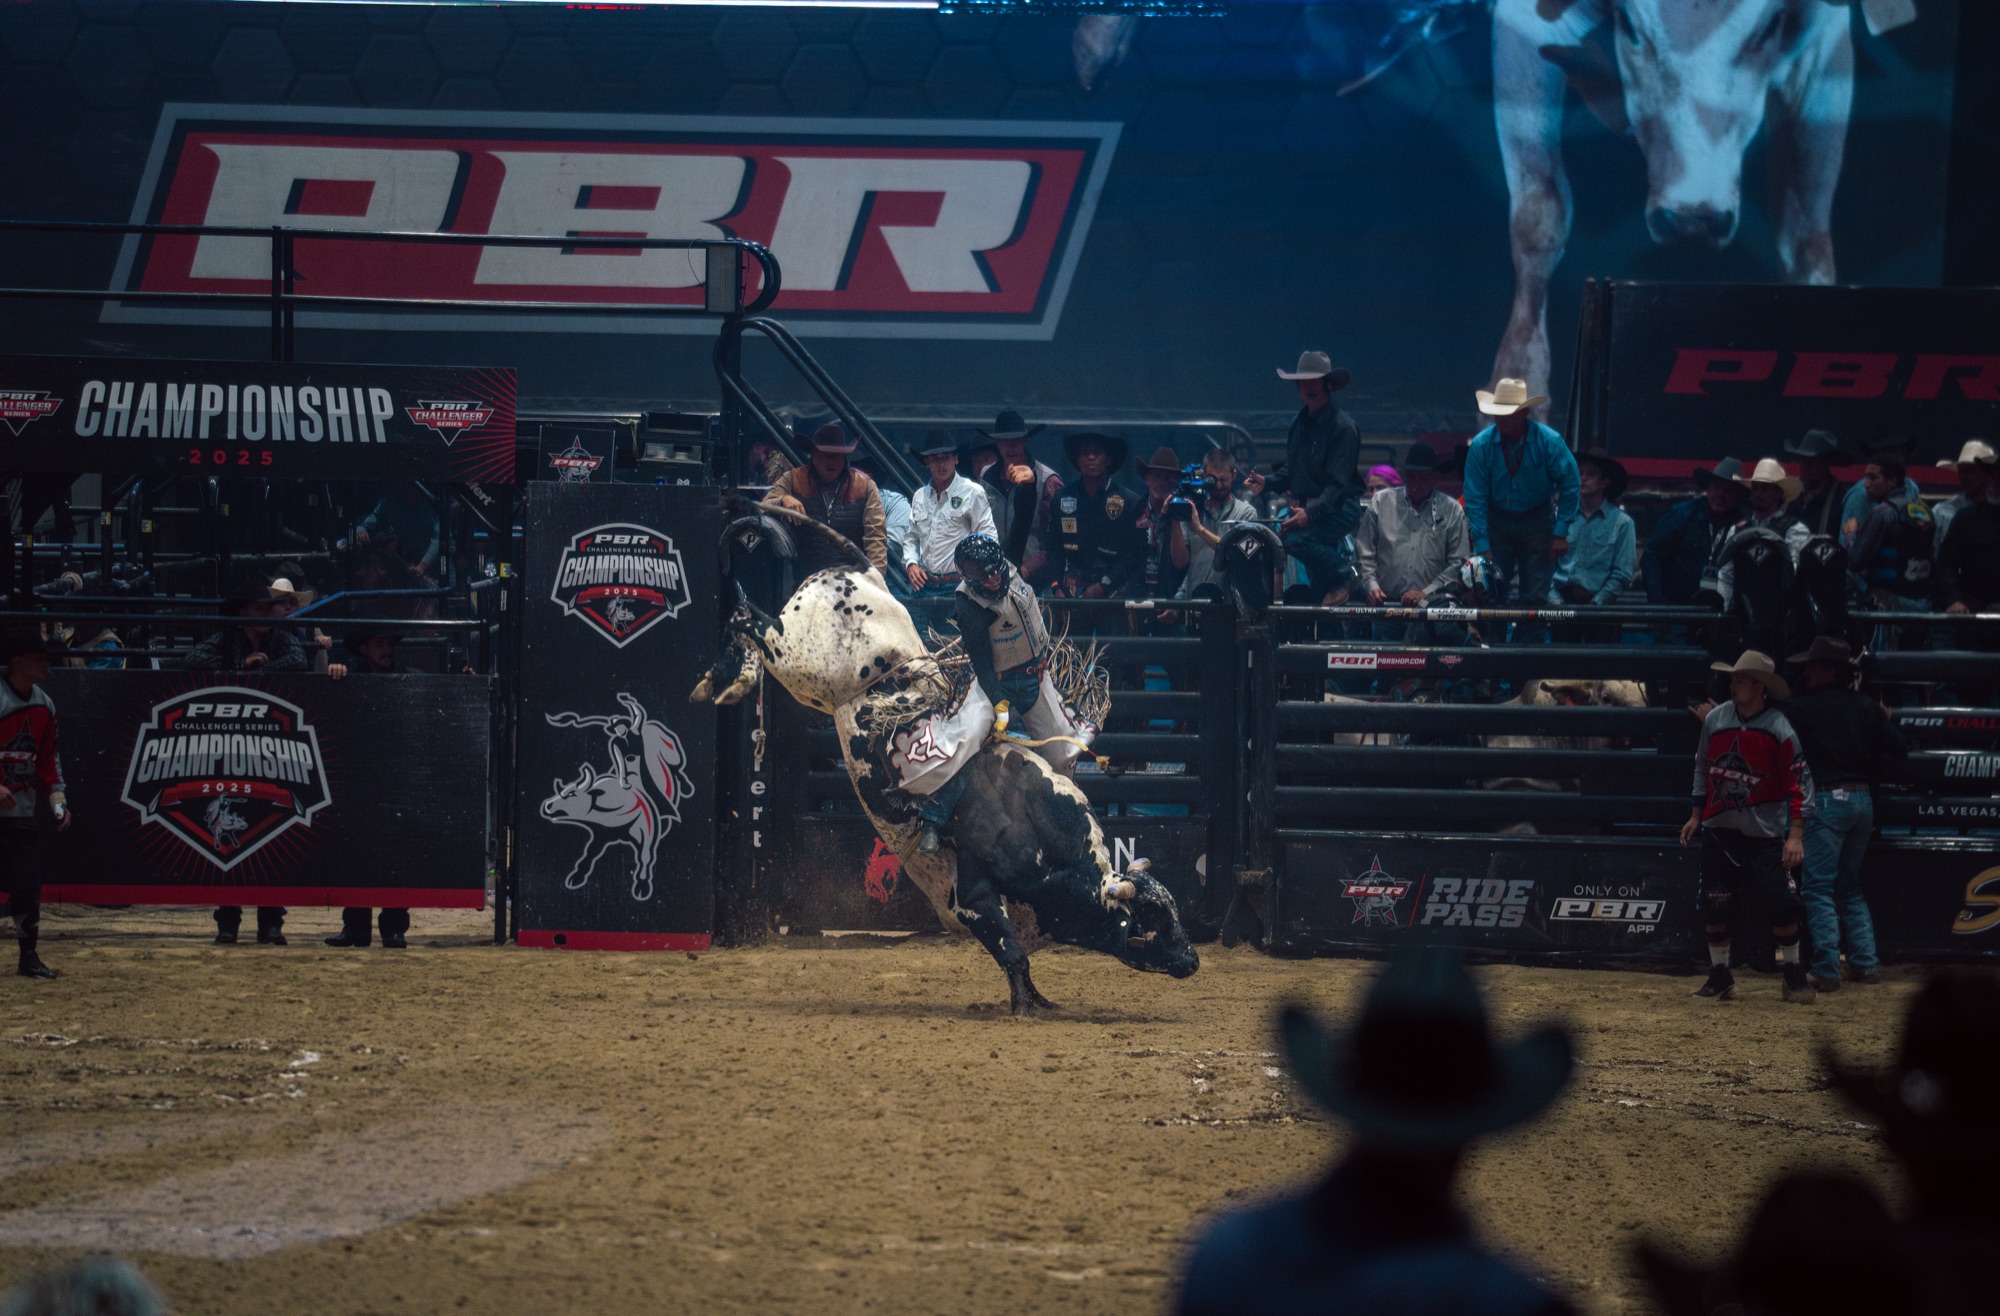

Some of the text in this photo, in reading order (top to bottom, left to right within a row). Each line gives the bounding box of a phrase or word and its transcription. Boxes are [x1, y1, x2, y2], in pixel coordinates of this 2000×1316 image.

[188, 143, 1032, 294] PBR
[1664, 347, 2000, 400] PBR
[0, 401, 52, 411] LLENGER
[75, 380, 394, 443] CHAMPIONSHIP
[431, 403, 469, 411] PBR
[415, 411, 484, 421] CHALLENGER
[189, 449, 273, 466] 2025
[553, 459, 597, 468] PBR
[595, 534, 650, 545] PBR
[586, 546, 631, 554] CHALLENGER
[561, 555, 680, 591] CHAMPIONSHIP
[604, 588, 638, 596] 2025
[1537, 609, 1575, 618] PENDLETON
[1330, 656, 1426, 666] PBR PBRSHOP.COM
[187, 703, 269, 718] PBR
[174, 722, 241, 731] CHALLENGER
[1900, 717, 2000, 729] PBR CHALL
[137, 734, 313, 785] CHAMPIONSHIP
[1943, 755, 2000, 778] CHAMP
[1709, 766, 1761, 785] PBR
[202, 783, 252, 794] 2025
[1918, 805, 1945, 815] LAS
[1348, 885, 1404, 896] PBR
[1428, 877, 1535, 905] RIDE
[1574, 885, 1640, 897] ONLY ON
[1557, 900, 1654, 919] PBR
[1420, 904, 1526, 928] PASS
[1627, 924, 1655, 934] APP
